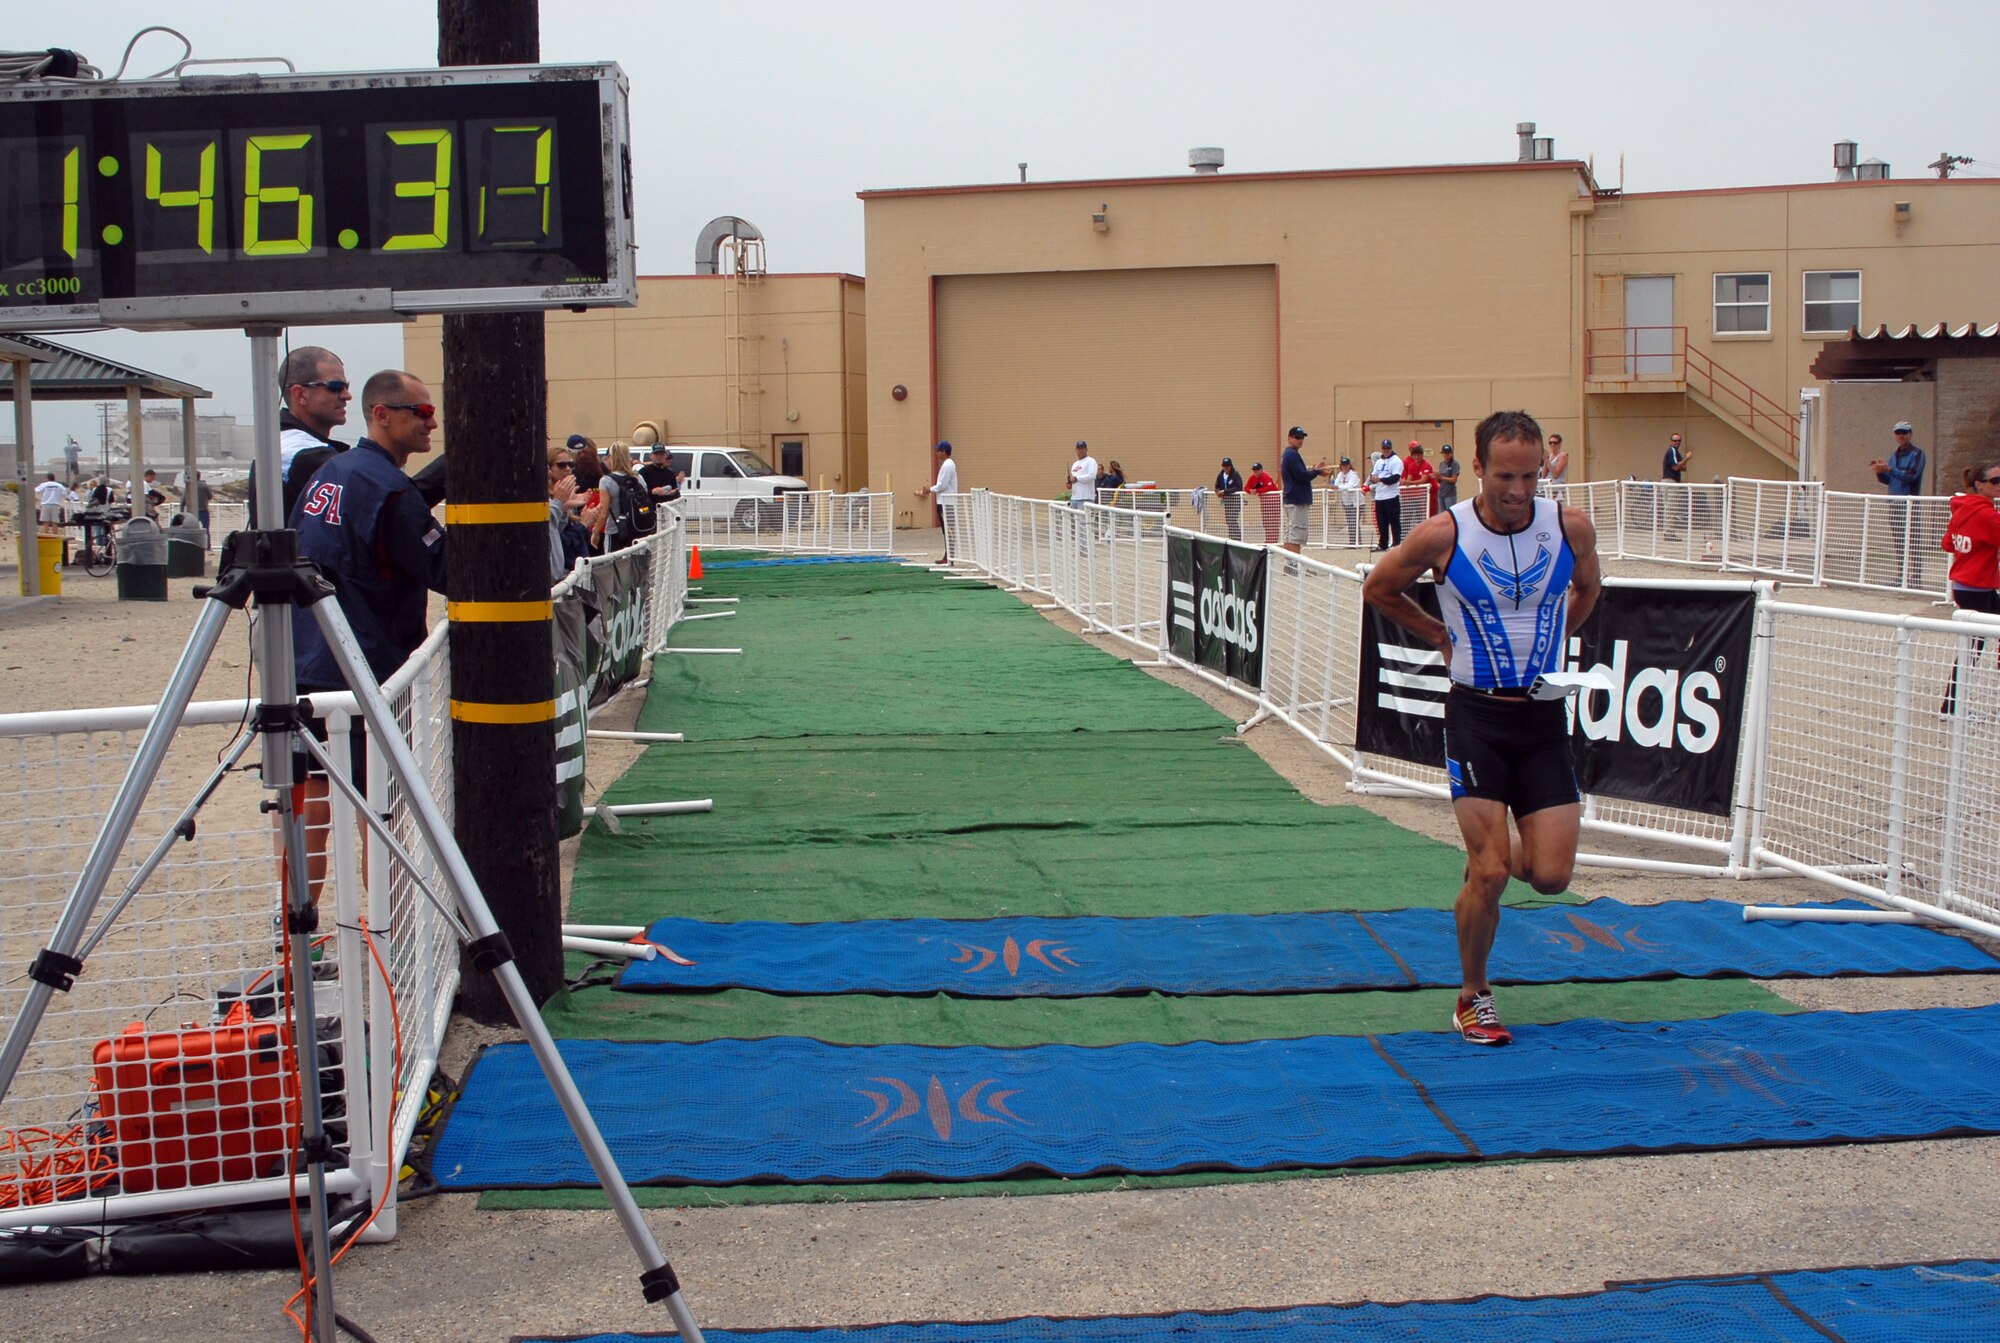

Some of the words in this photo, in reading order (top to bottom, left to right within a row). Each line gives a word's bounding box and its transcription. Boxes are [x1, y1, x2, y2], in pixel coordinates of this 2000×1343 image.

[16, 277, 81, 296] cc3000
[1477, 599, 1497, 625] US
[1488, 631, 1511, 669] AIR
[1531, 592, 1558, 668] FORCE
[1562, 636, 1722, 753] idas
